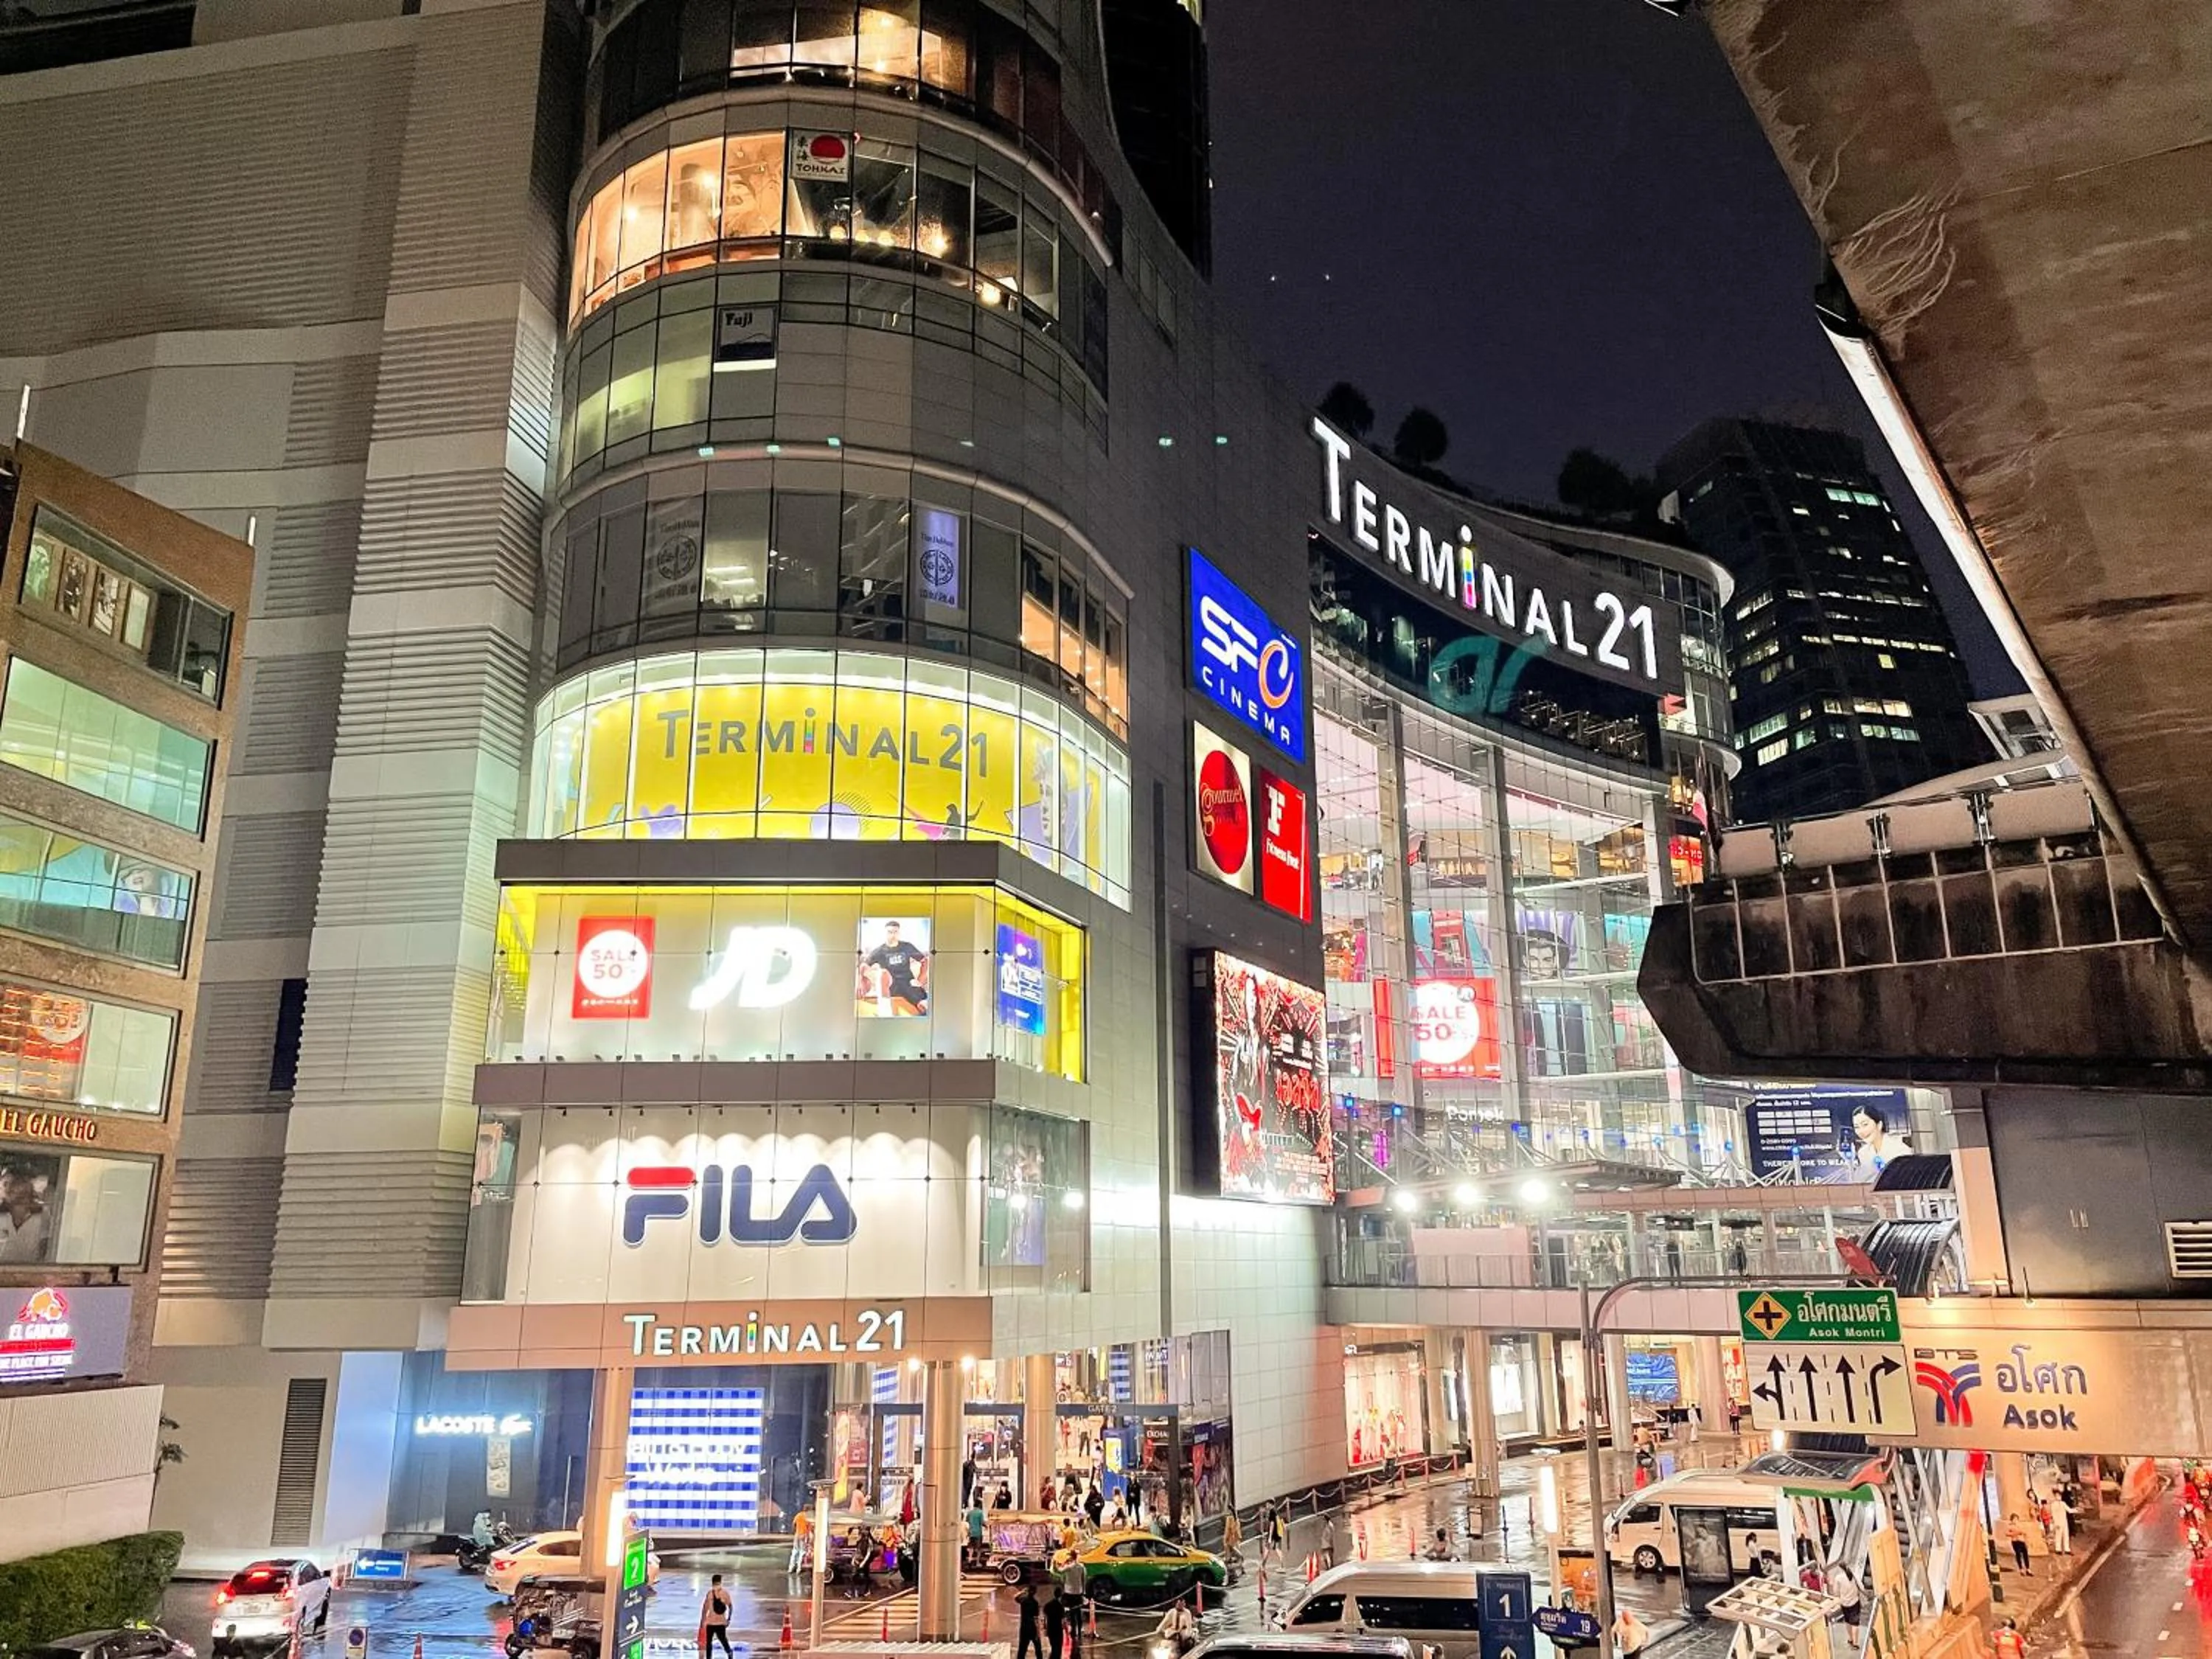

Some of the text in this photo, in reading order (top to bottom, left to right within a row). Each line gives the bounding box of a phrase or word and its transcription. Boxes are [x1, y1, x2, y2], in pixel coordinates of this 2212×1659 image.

[1202, 665, 1290, 745] CINEMA
[689, 925, 818, 1009] JD
[27, 1113, 97, 1142] GAUCHO
[622, 1163, 859, 1248] FILA
[1797, 1292, 1891, 1322] อโศกมนตรี
[1809, 1328, 1885, 1338] Asok Montri
[1914, 1347, 1978, 1360] BTS
[1996, 1343, 2087, 1395] อโศก
[417, 1416, 495, 1434] LACOSTE
[2003, 1404, 2079, 1430] Asok
[1499, 1593, 1511, 1618] 1
